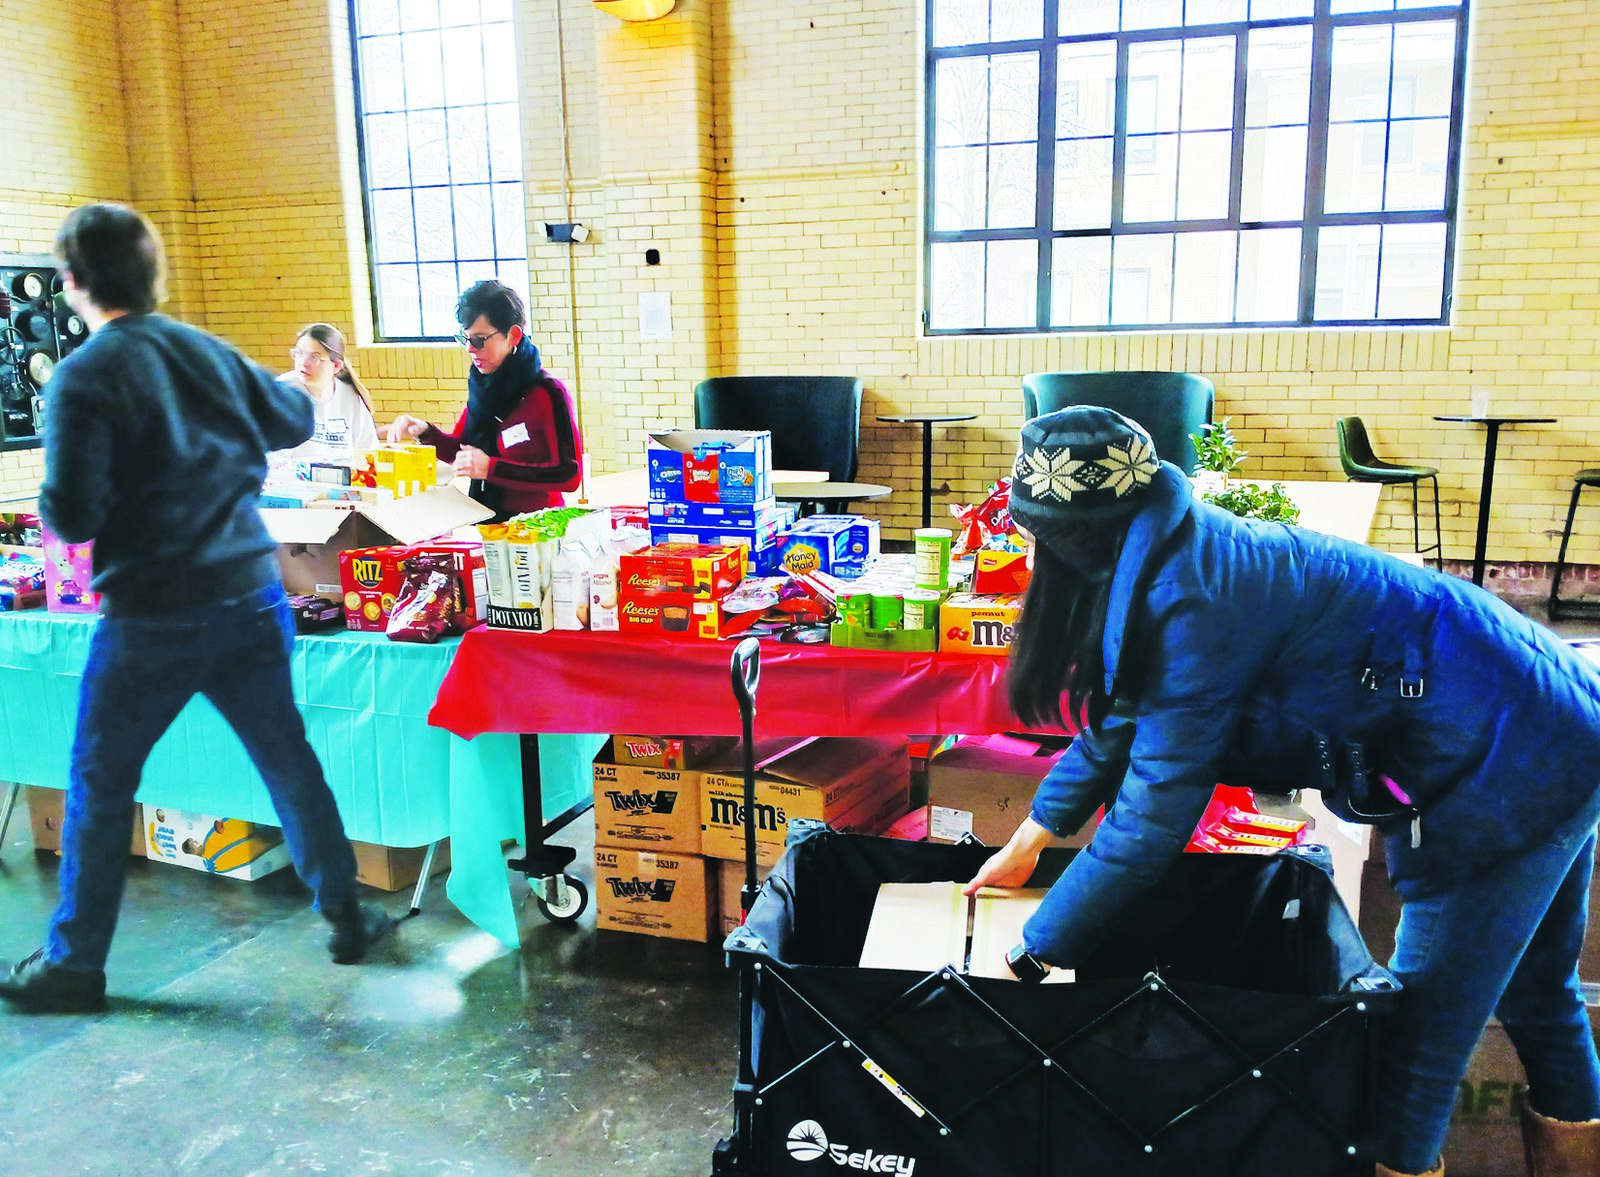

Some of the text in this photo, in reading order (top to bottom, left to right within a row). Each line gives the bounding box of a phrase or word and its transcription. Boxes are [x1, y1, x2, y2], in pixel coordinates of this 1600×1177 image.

[785, 552, 817, 564] Honey
[352, 558, 384, 581] RITZ
[791, 560, 815, 571] Maid
[628, 573, 661, 586] Reese's
[622, 601, 660, 616] Reese's
[491, 608, 533, 627] POTATO
[640, 616, 654, 624] CUP
[595, 767, 617, 776] 24 CT
[656, 772, 680, 780] 35387
[707, 777, 715, 785] 24
[596, 853, 617, 863] 24 CT
[656, 859, 679, 870] 35387
